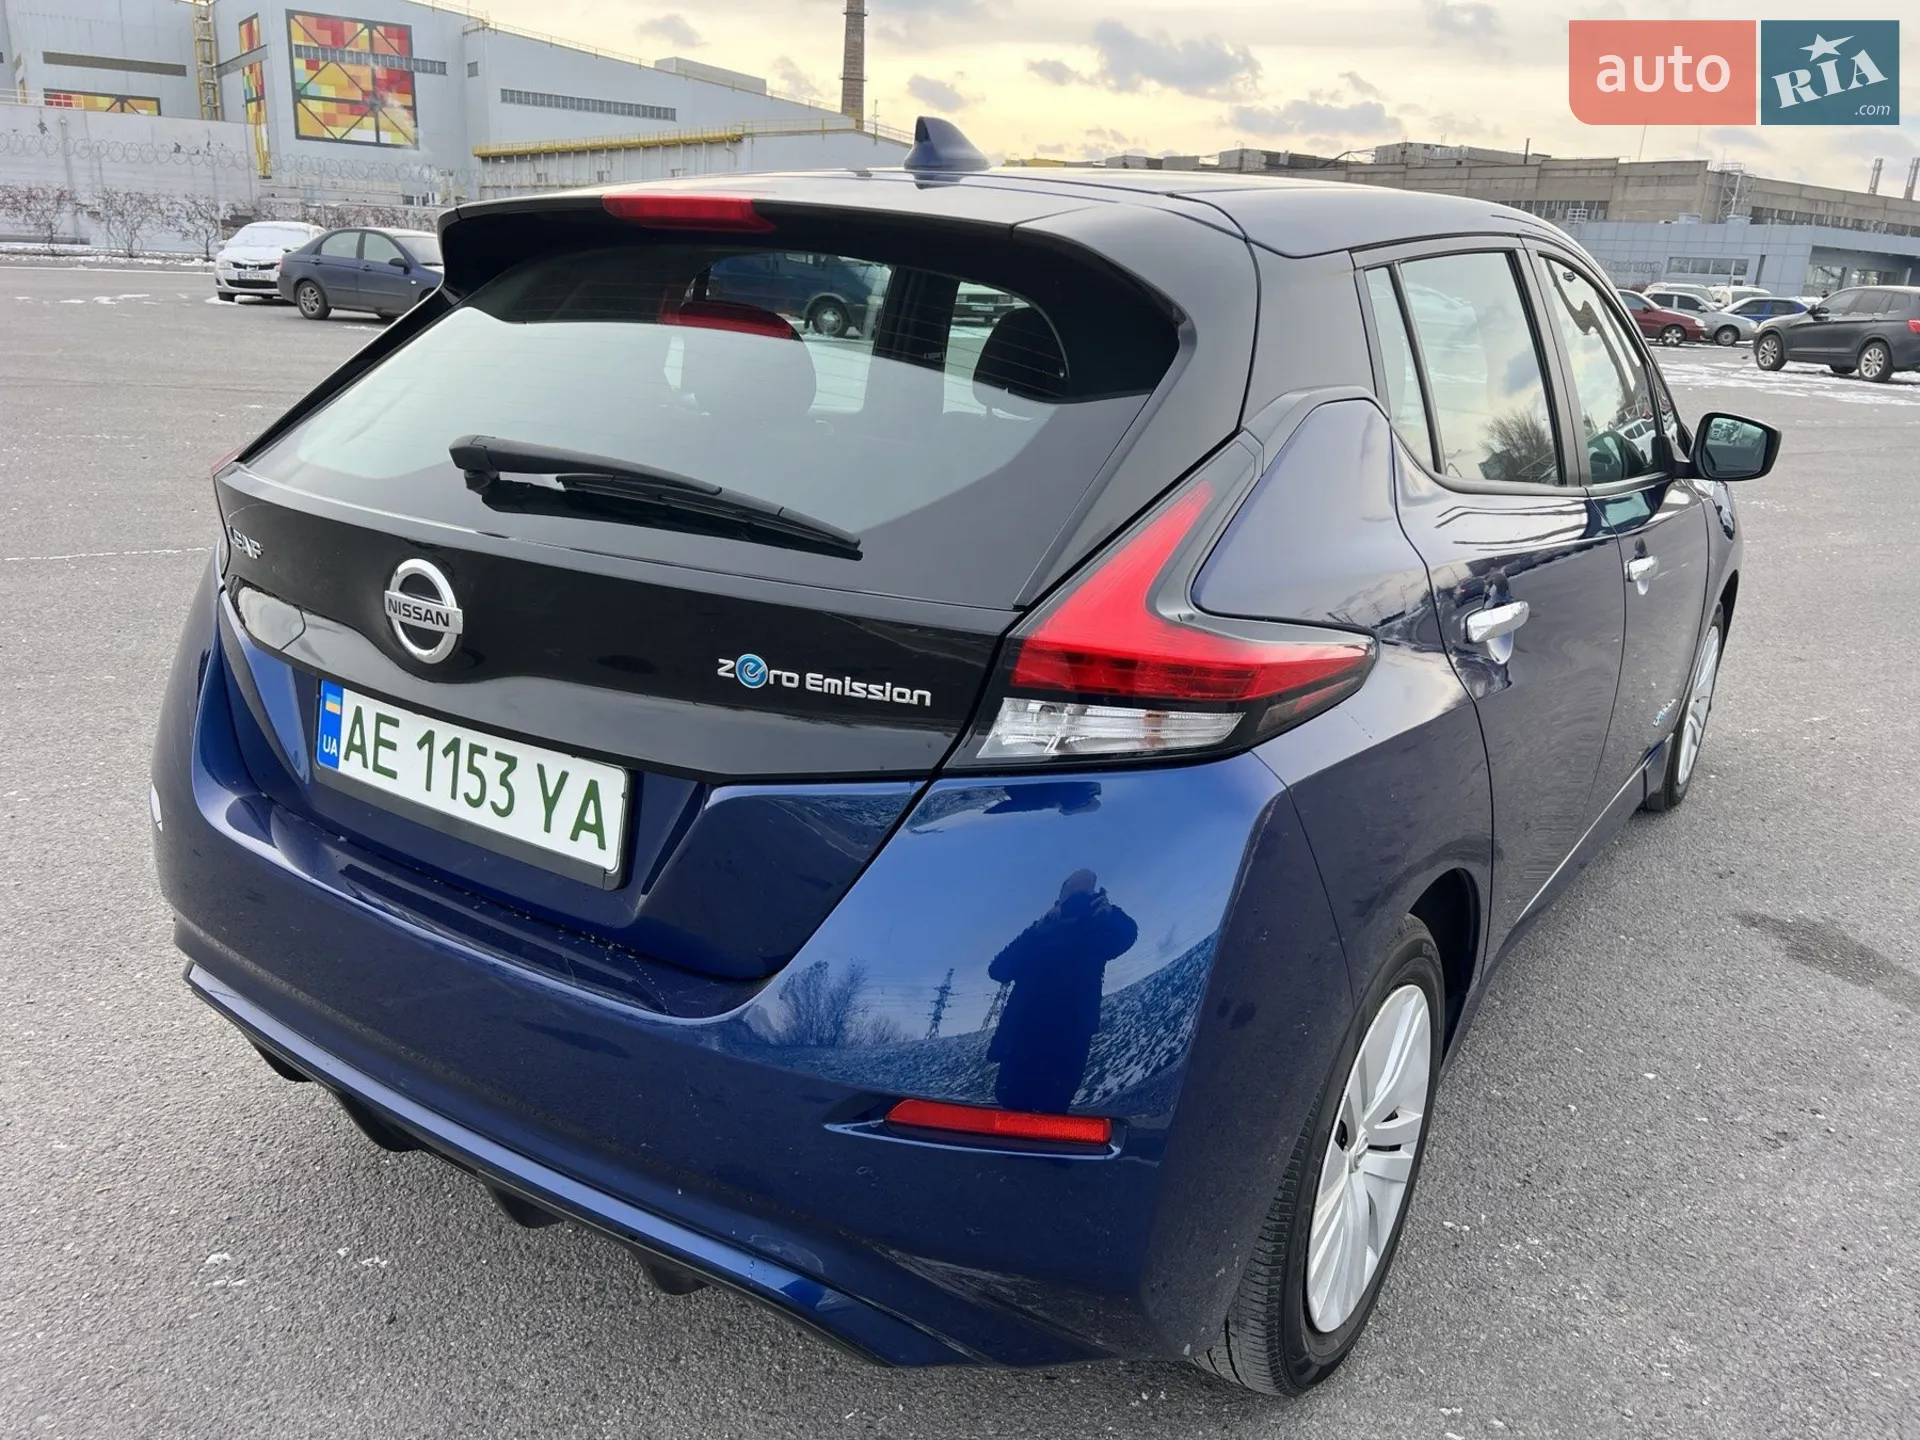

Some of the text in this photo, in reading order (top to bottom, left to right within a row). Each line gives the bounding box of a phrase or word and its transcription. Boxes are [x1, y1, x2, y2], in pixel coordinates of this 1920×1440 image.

[387, 598, 450, 628] NISSAN
[805, 673, 931, 706] Emission
[322, 734, 338, 757] UA
[343, 705, 607, 851] AE 1153 YA
